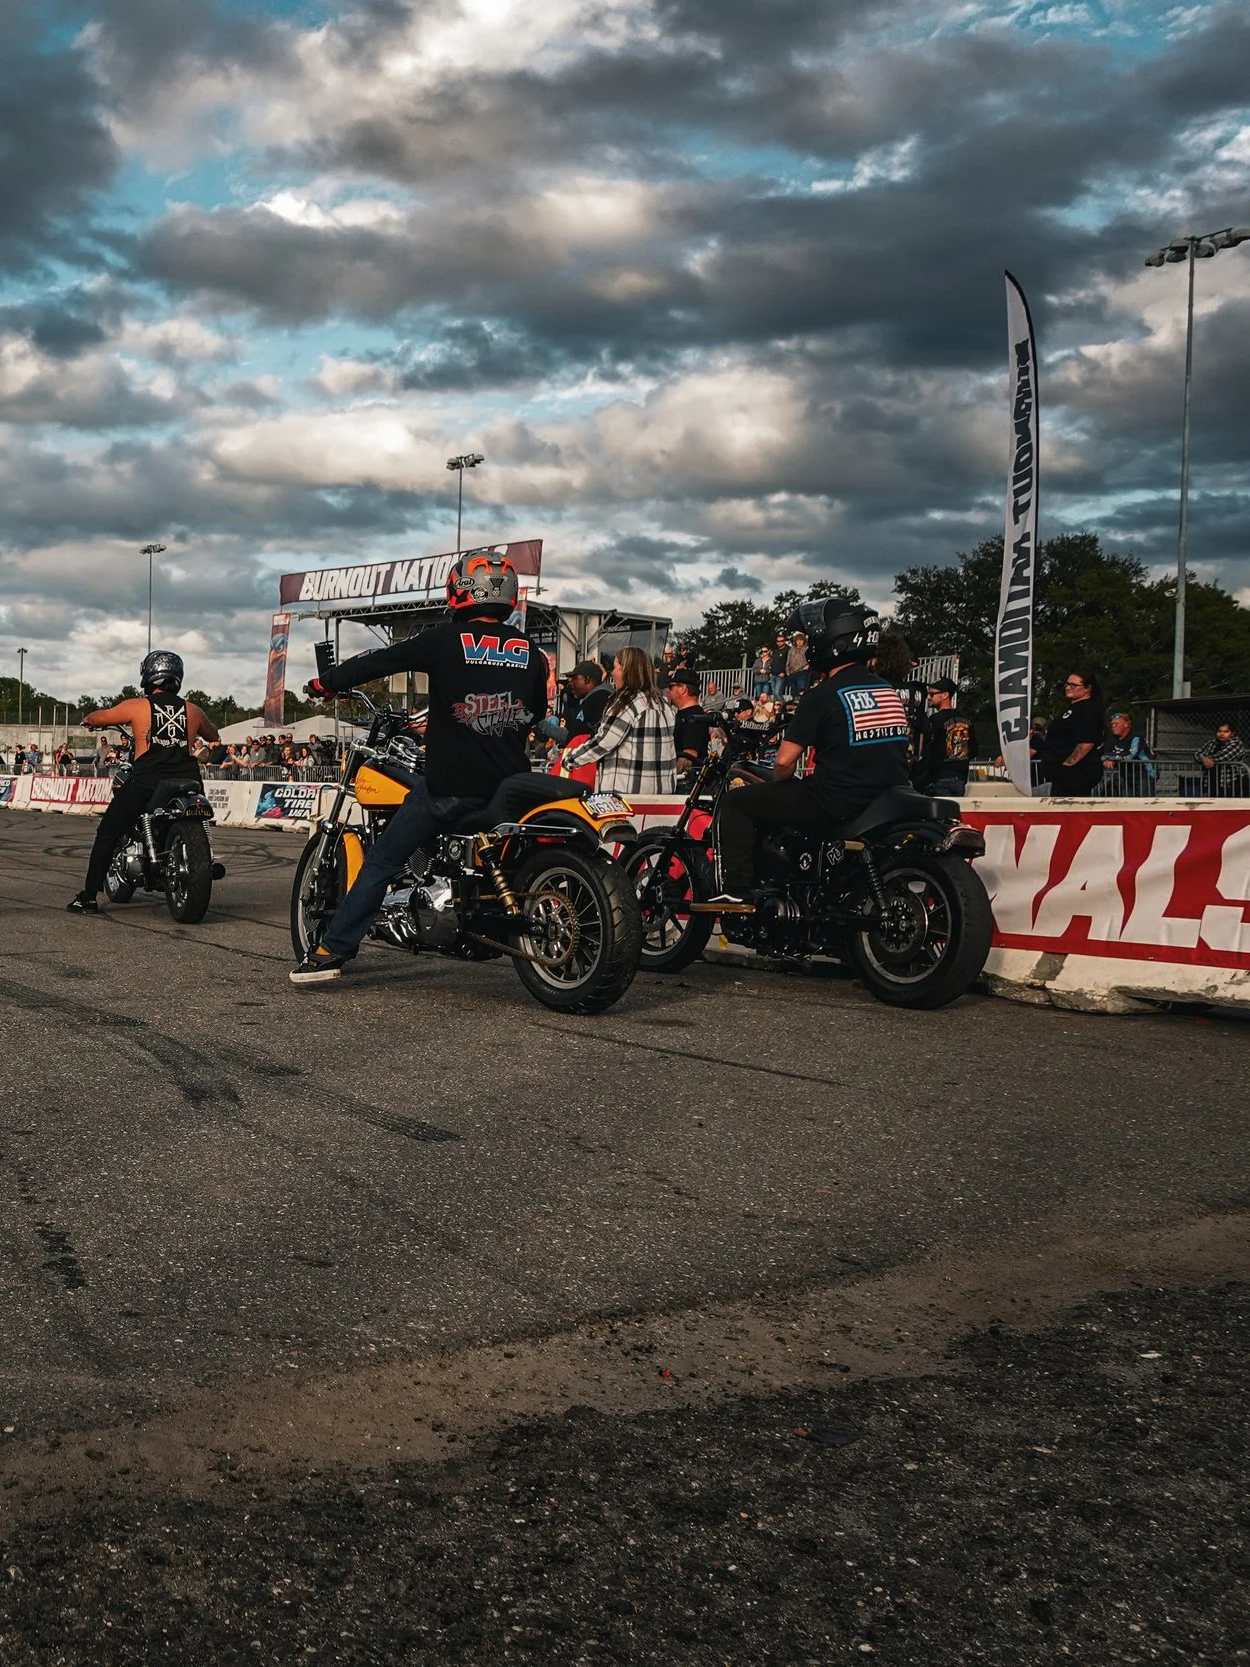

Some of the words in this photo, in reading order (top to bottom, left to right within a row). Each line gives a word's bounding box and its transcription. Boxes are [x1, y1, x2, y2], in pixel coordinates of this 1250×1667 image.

[299, 562, 393, 601] BURNOUT
[390, 552, 468, 593] NATIO
[460, 633, 529, 665] VLG
[464, 691, 521, 714] STEEL
[75, 778, 114, 803] NATION
[274, 787, 317, 799] COLOR
[284, 799, 314, 809] TIRE
[970, 824, 1250, 954] NALS
